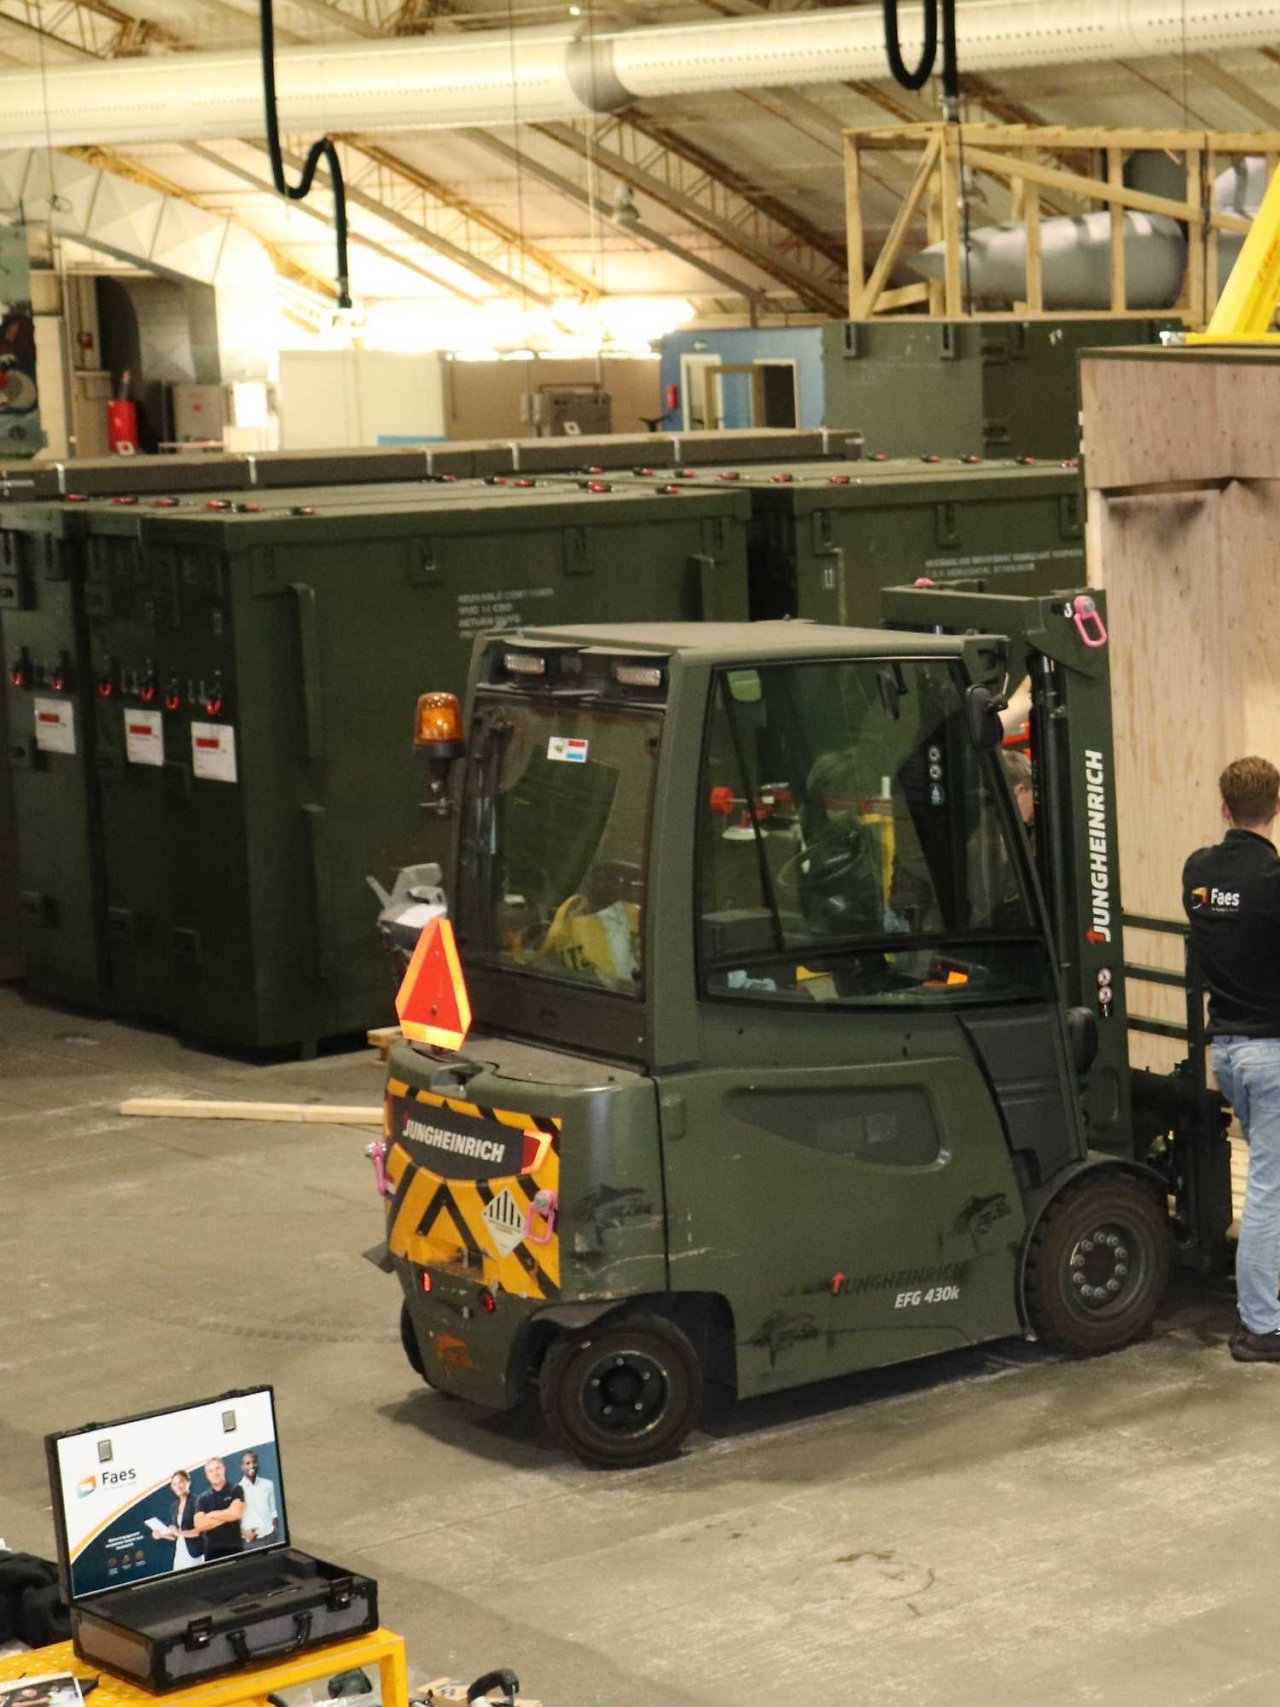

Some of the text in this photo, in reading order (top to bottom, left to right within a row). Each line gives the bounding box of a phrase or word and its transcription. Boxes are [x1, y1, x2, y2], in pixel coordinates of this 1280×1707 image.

[1085, 749, 1111, 944] JUNGHEINRICH
[1210, 887, 1240, 906] Faes
[402, 1119, 505, 1163] JUNGHEINRICH
[894, 1285, 960, 1309] EFG 430k
[102, 1468, 136, 1485] Faes
